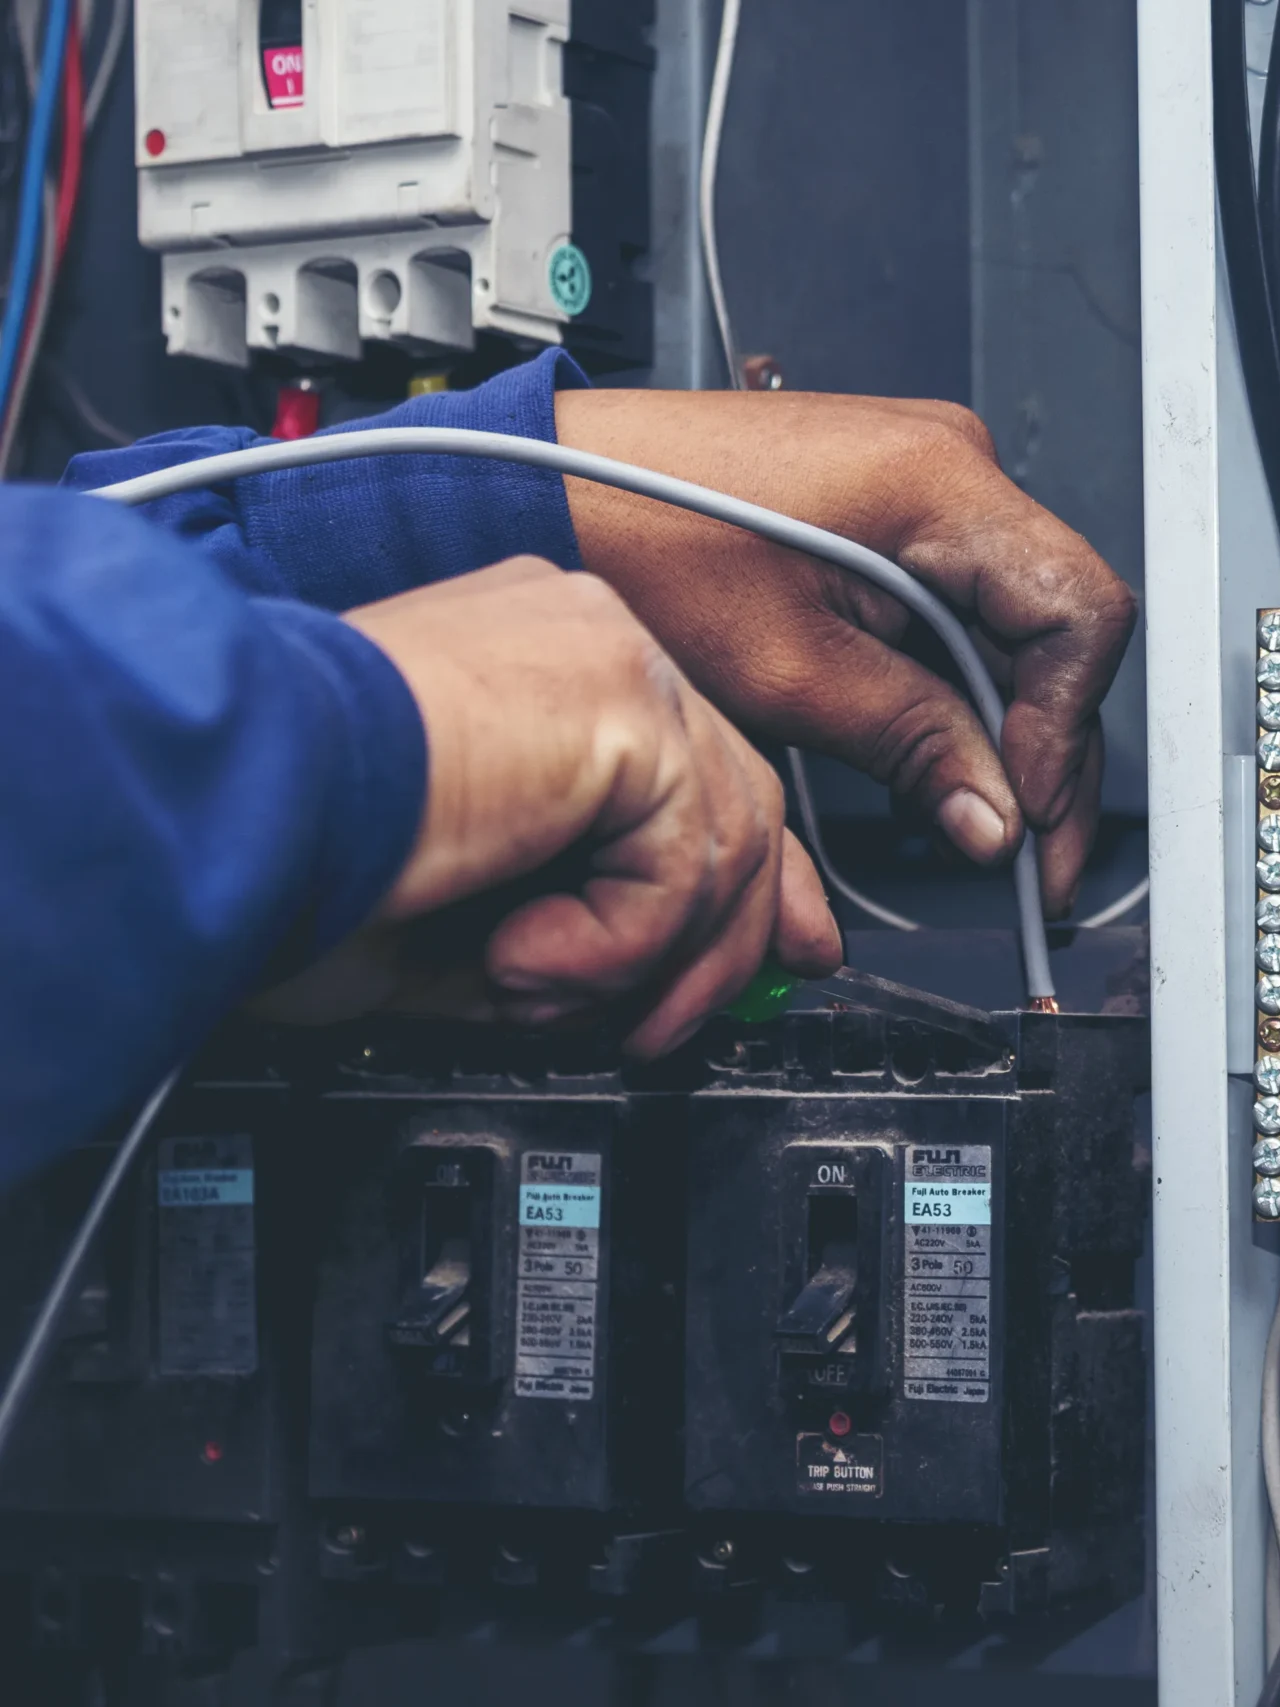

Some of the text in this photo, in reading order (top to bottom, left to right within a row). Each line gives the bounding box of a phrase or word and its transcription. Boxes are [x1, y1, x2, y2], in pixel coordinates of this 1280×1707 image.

[271, 54, 303, 75] ON
[913, 1150, 960, 1164] FUJI
[817, 1165, 845, 1183] ON
[912, 1165, 986, 1177] ELECTRIC
[912, 1188, 986, 1197] Fuji Auto Breaker
[526, 1206, 563, 1221] EA53
[912, 1203, 952, 1217] EA53
[564, 1261, 582, 1275] 50
[911, 1257, 920, 1271] 3
[953, 1260, 973, 1275] 50
[808, 1465, 874, 1479] TRIP BUTTON
[827, 1483, 844, 1491] PUSH
